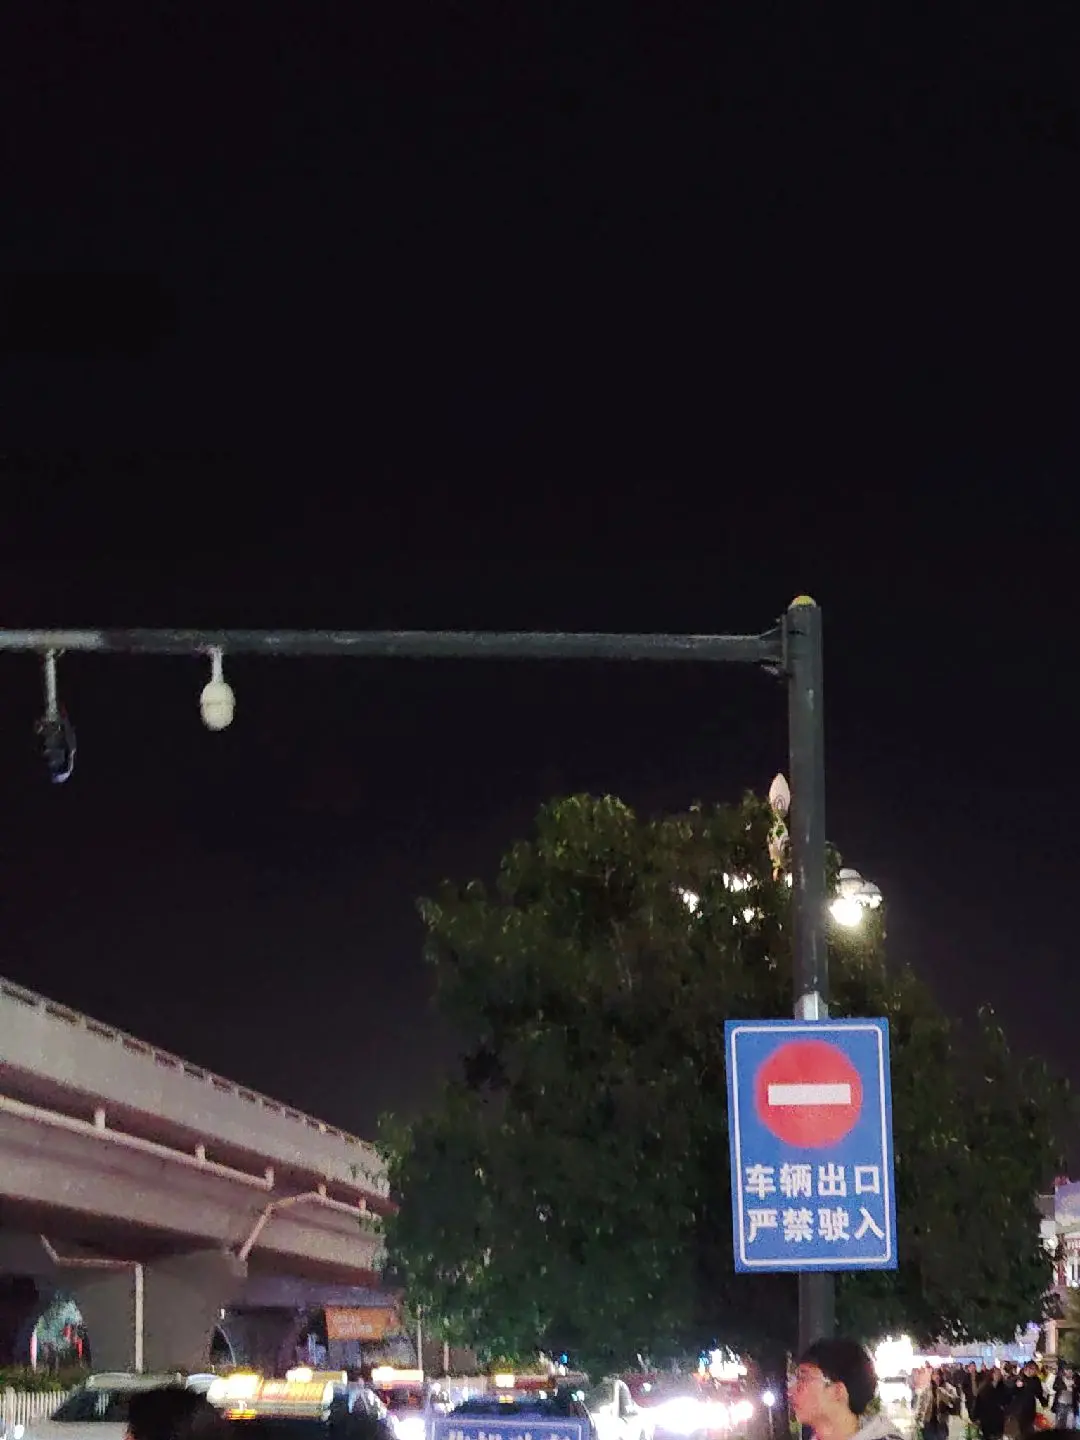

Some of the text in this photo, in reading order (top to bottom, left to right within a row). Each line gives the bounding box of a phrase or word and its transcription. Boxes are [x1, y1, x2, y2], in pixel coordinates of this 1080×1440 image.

[745, 1163, 881, 1199] 车辆出口
[746, 1206, 885, 1243] 严禁驶入
